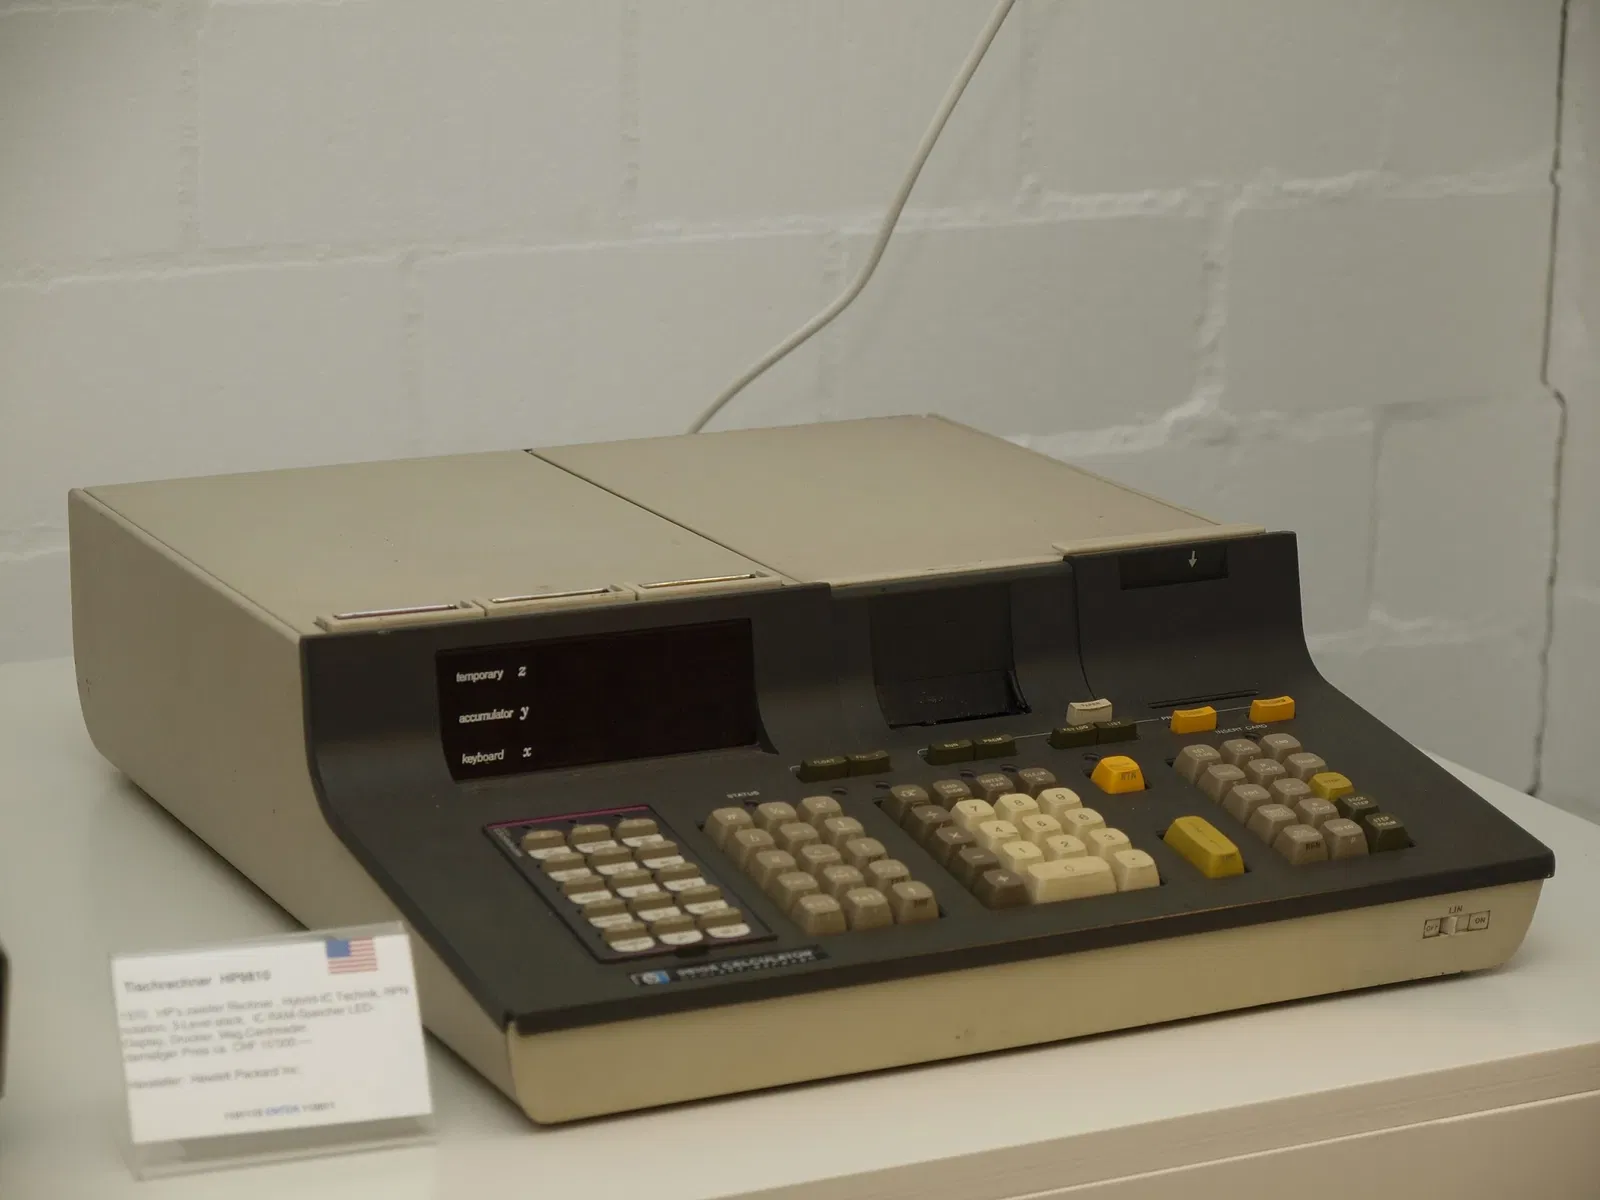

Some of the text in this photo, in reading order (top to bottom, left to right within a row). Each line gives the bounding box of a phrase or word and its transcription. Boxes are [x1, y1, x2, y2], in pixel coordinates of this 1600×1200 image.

[455, 668, 504, 683] temporary
[458, 704, 530, 724] accumulator y
[1215, 723, 1268, 735] INSERT CARD
[461, 746, 533, 765] keyboard x
[726, 790, 760, 799] STATUS
[1055, 793, 1066, 801] 9
[1014, 799, 1024, 807] 8
[970, 805, 978, 813] 7
[1078, 813, 1089, 821] 6
[1103, 833, 1115, 841] 3
[1060, 840, 1070, 848] 2
[1475, 916, 1486, 924] ON
